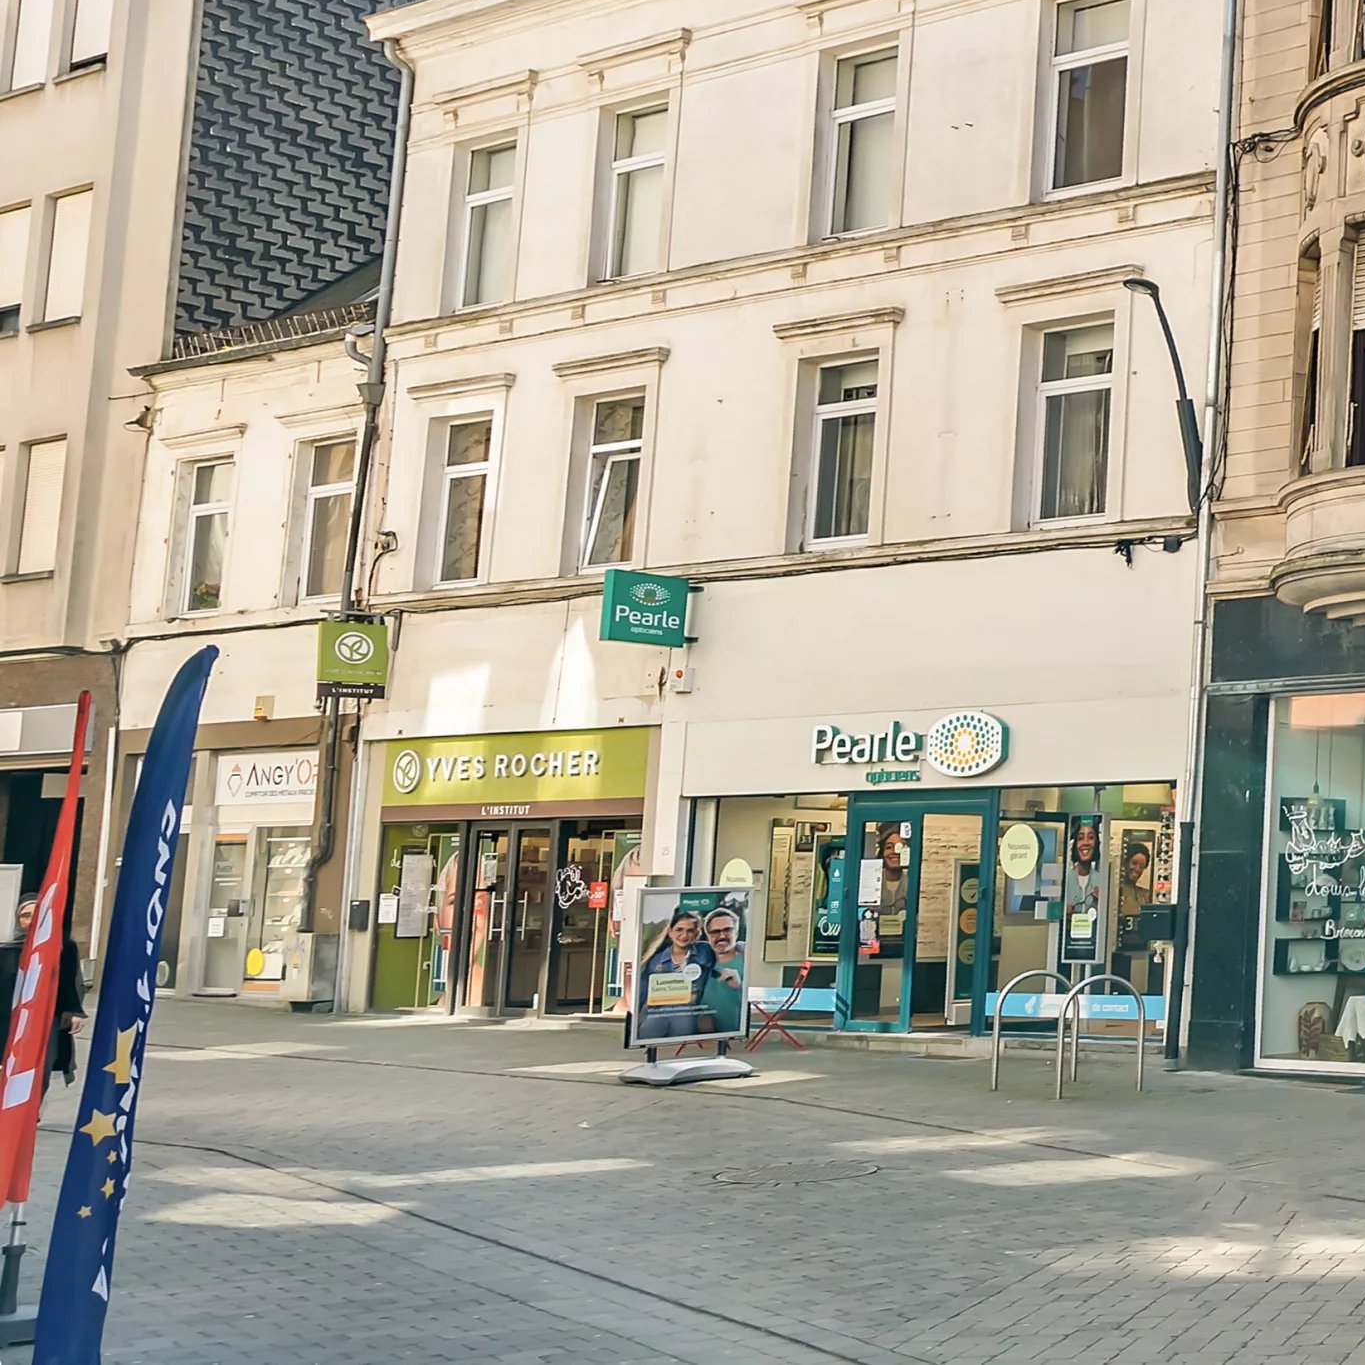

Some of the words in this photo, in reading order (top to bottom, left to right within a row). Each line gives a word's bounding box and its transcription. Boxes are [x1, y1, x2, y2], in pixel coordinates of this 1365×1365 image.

[615, 604, 680, 629] Pearle
[630, 626, 663, 636] opticiens
[331, 687, 375, 695] L'INSTITUT
[811, 720, 920, 765] Pearle
[426, 754, 487, 781] YVES
[494, 749, 601, 778] ROCHER
[480, 804, 531, 816] L'INSTITUT
[656, 977, 685, 986] Lunettes
